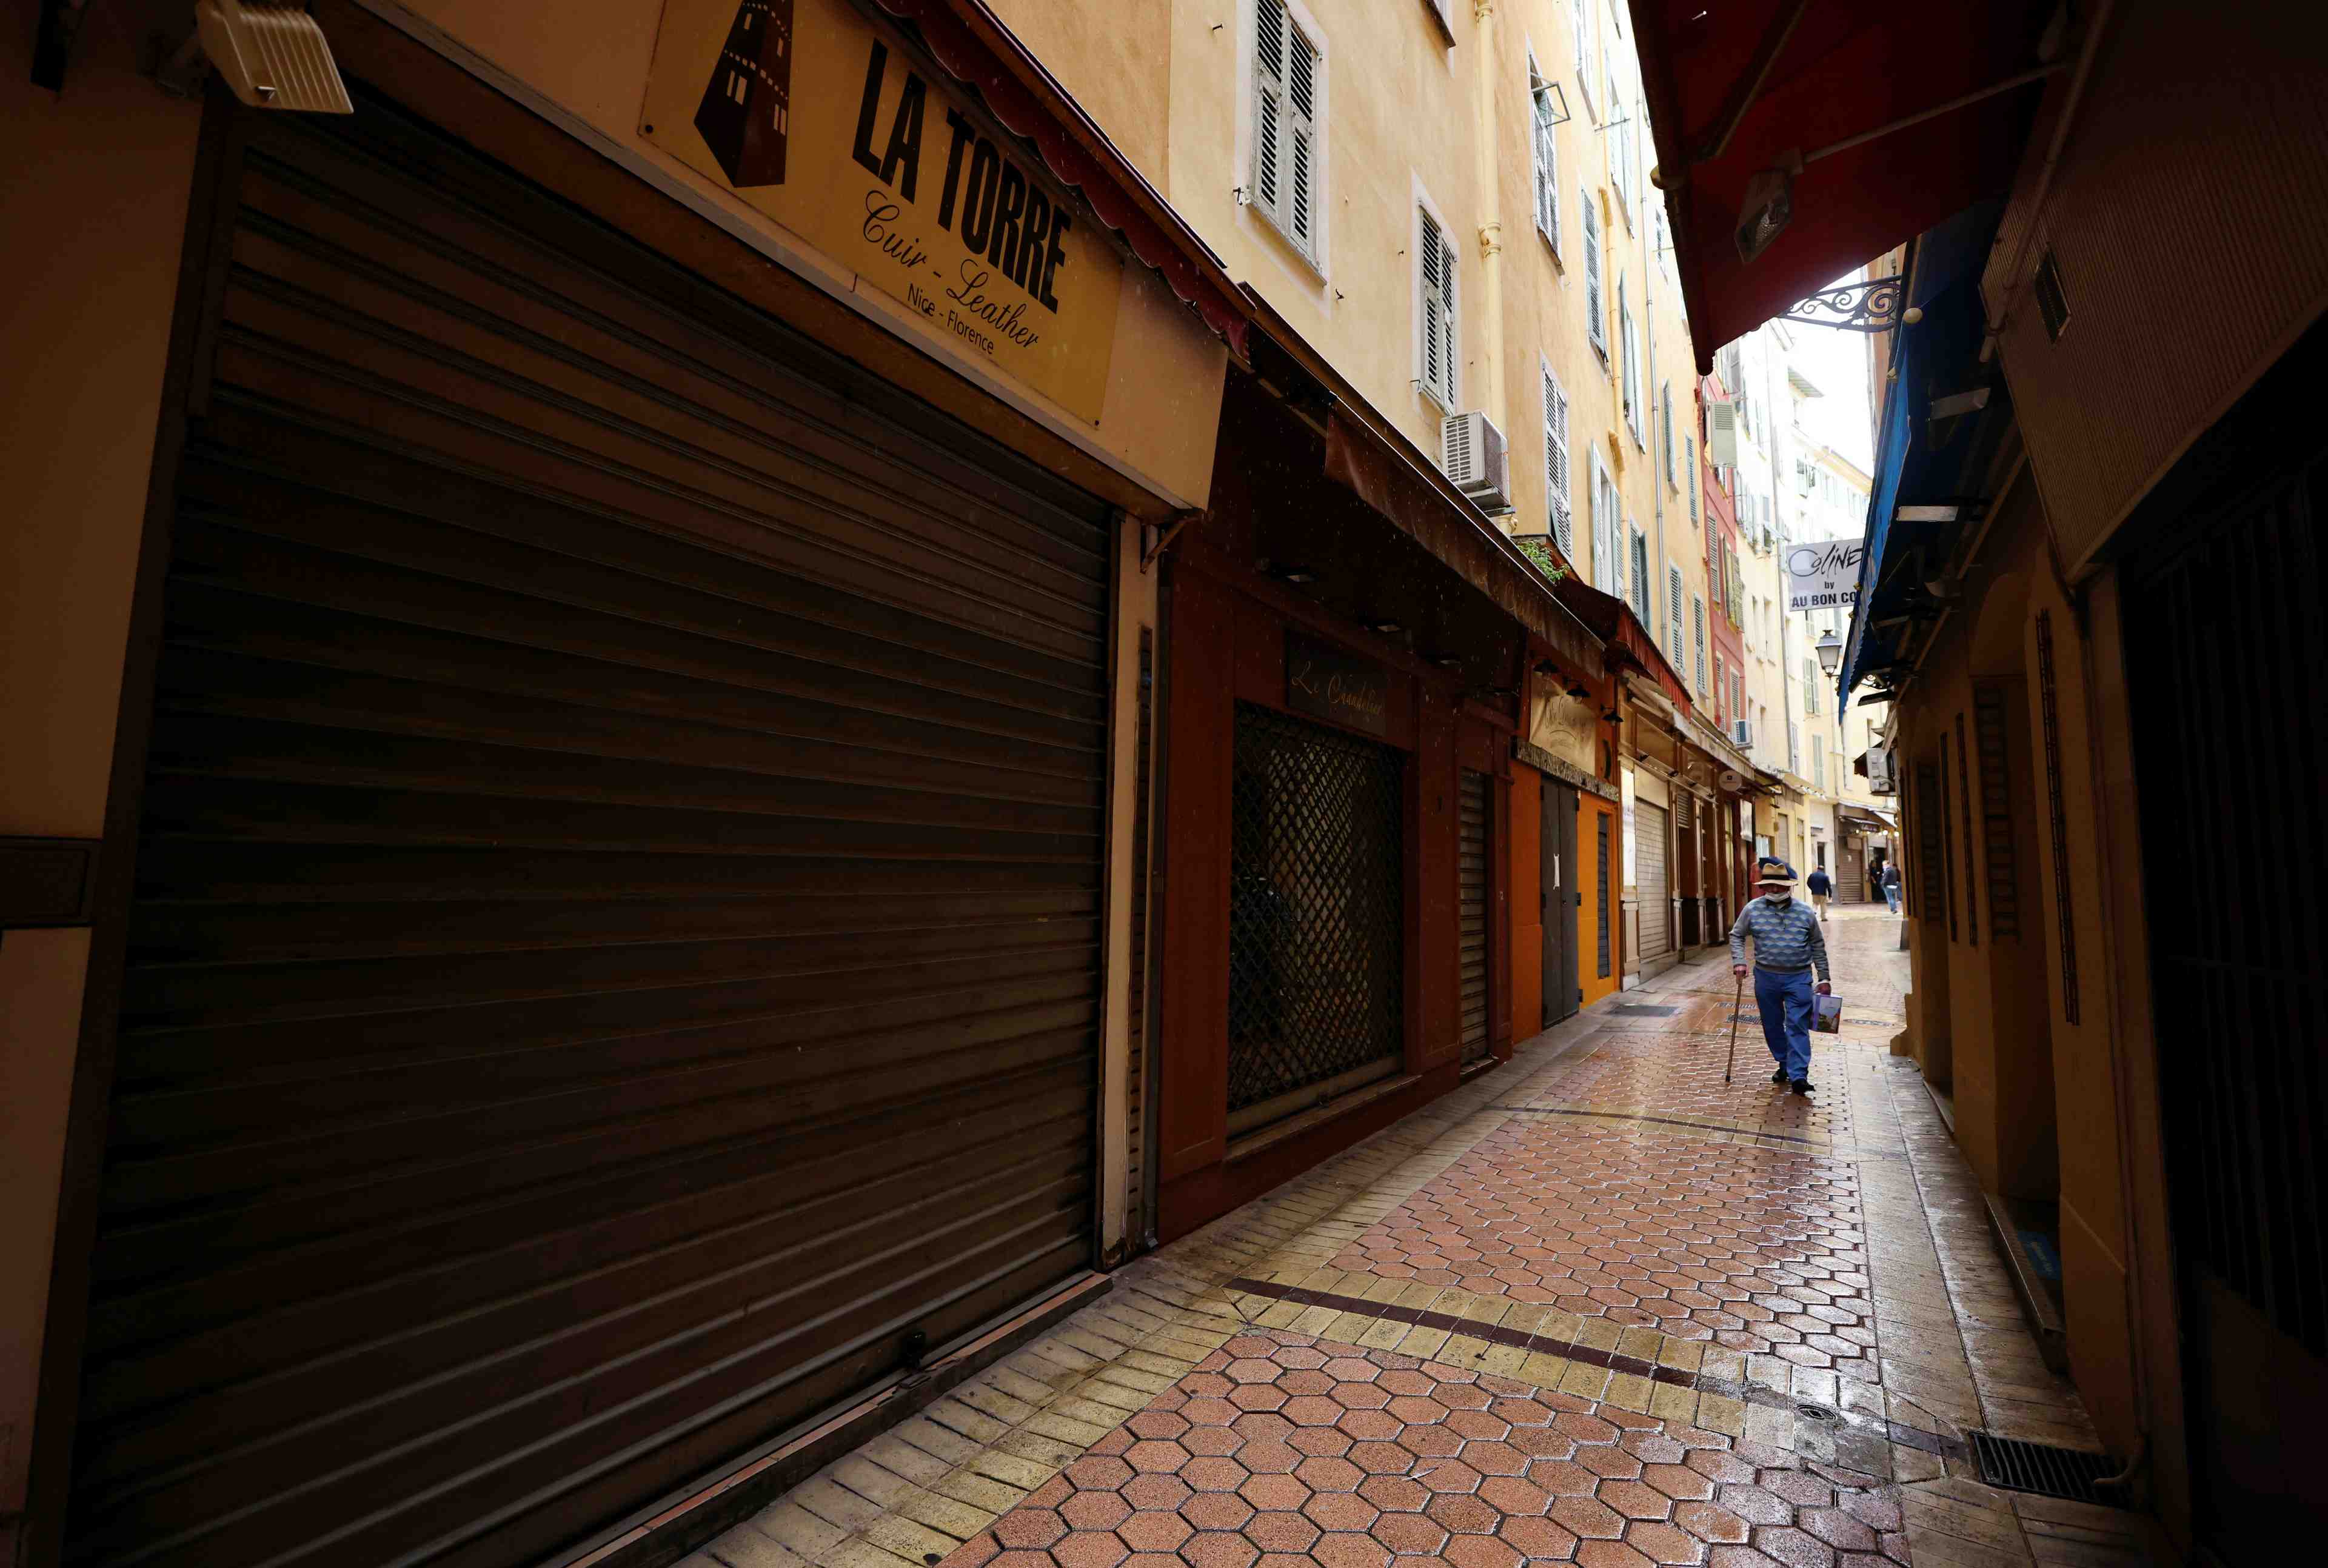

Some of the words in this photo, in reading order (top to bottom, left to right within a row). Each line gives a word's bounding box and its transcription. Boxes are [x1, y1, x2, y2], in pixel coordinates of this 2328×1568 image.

[852, 38, 926, 204] LA
[937, 106, 1072, 314] TORRE
[863, 190, 927, 268] Cuir
[946, 259, 1039, 349] Leather
[908, 283, 935, 318] Nice
[947, 310, 994, 356] Florence
[1792, 596, 1807, 607] AU
[1812, 594, 1836, 606] BON
[1291, 659, 1320, 695] Le
